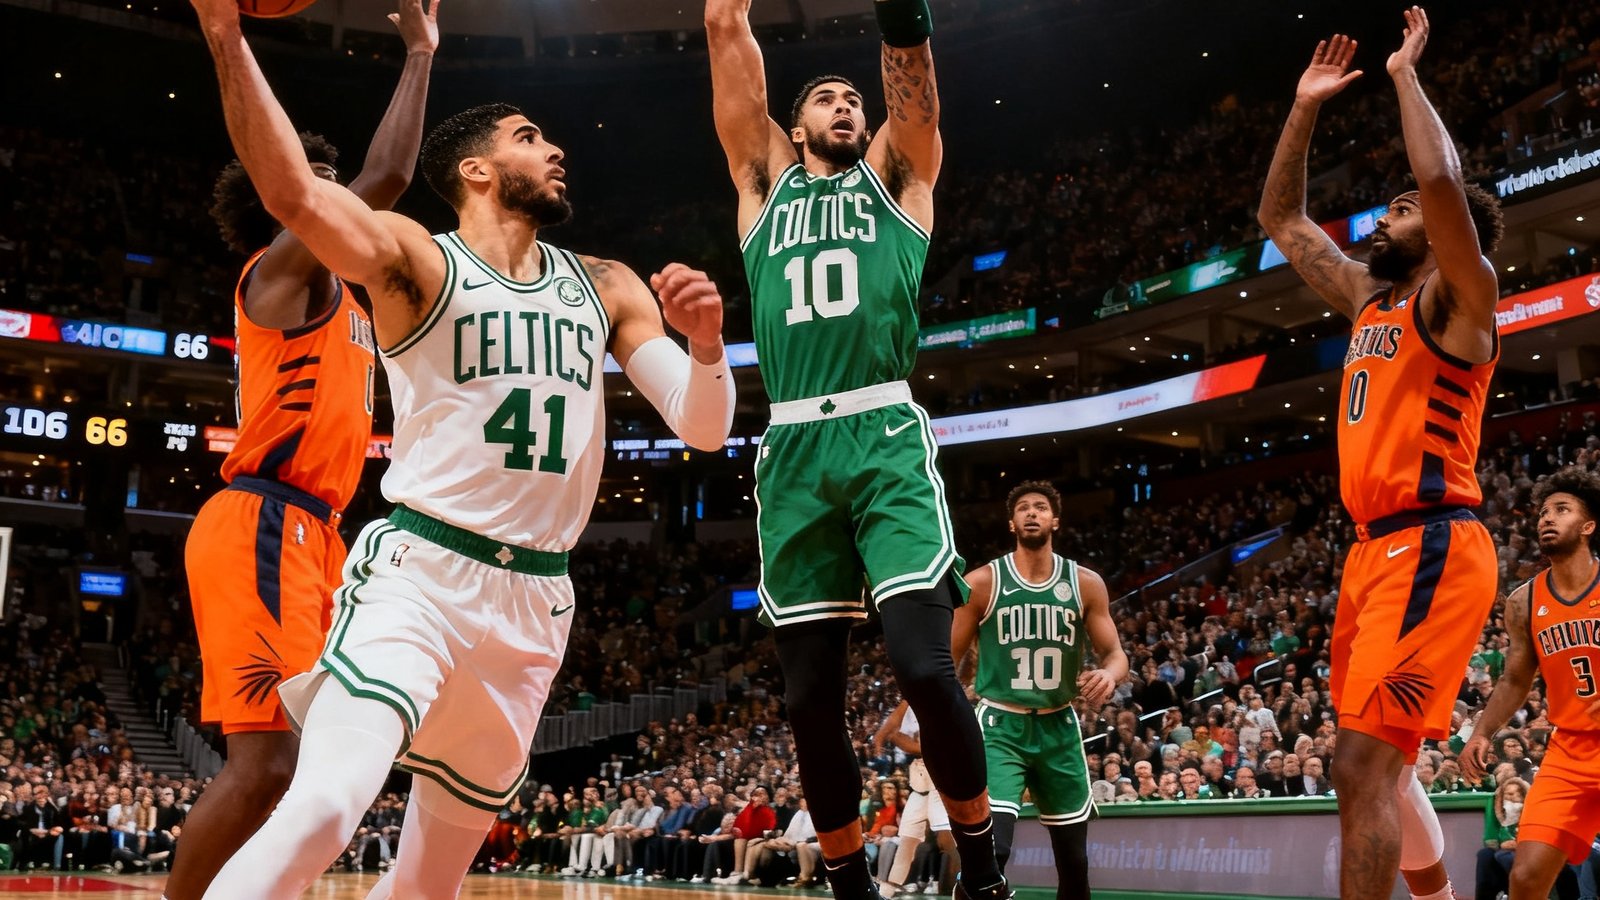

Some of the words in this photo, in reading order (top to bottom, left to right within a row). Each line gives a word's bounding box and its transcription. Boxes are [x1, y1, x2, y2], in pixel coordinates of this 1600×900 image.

[784, 247, 860, 326] 10
[174, 333, 209, 360] 66
[454, 310, 594, 392] CELTICS
[85, 416, 128, 447] 66
[483, 387, 567, 475] 41
[1011, 647, 1063, 690] 10
[1570, 656, 1597, 697] 3
